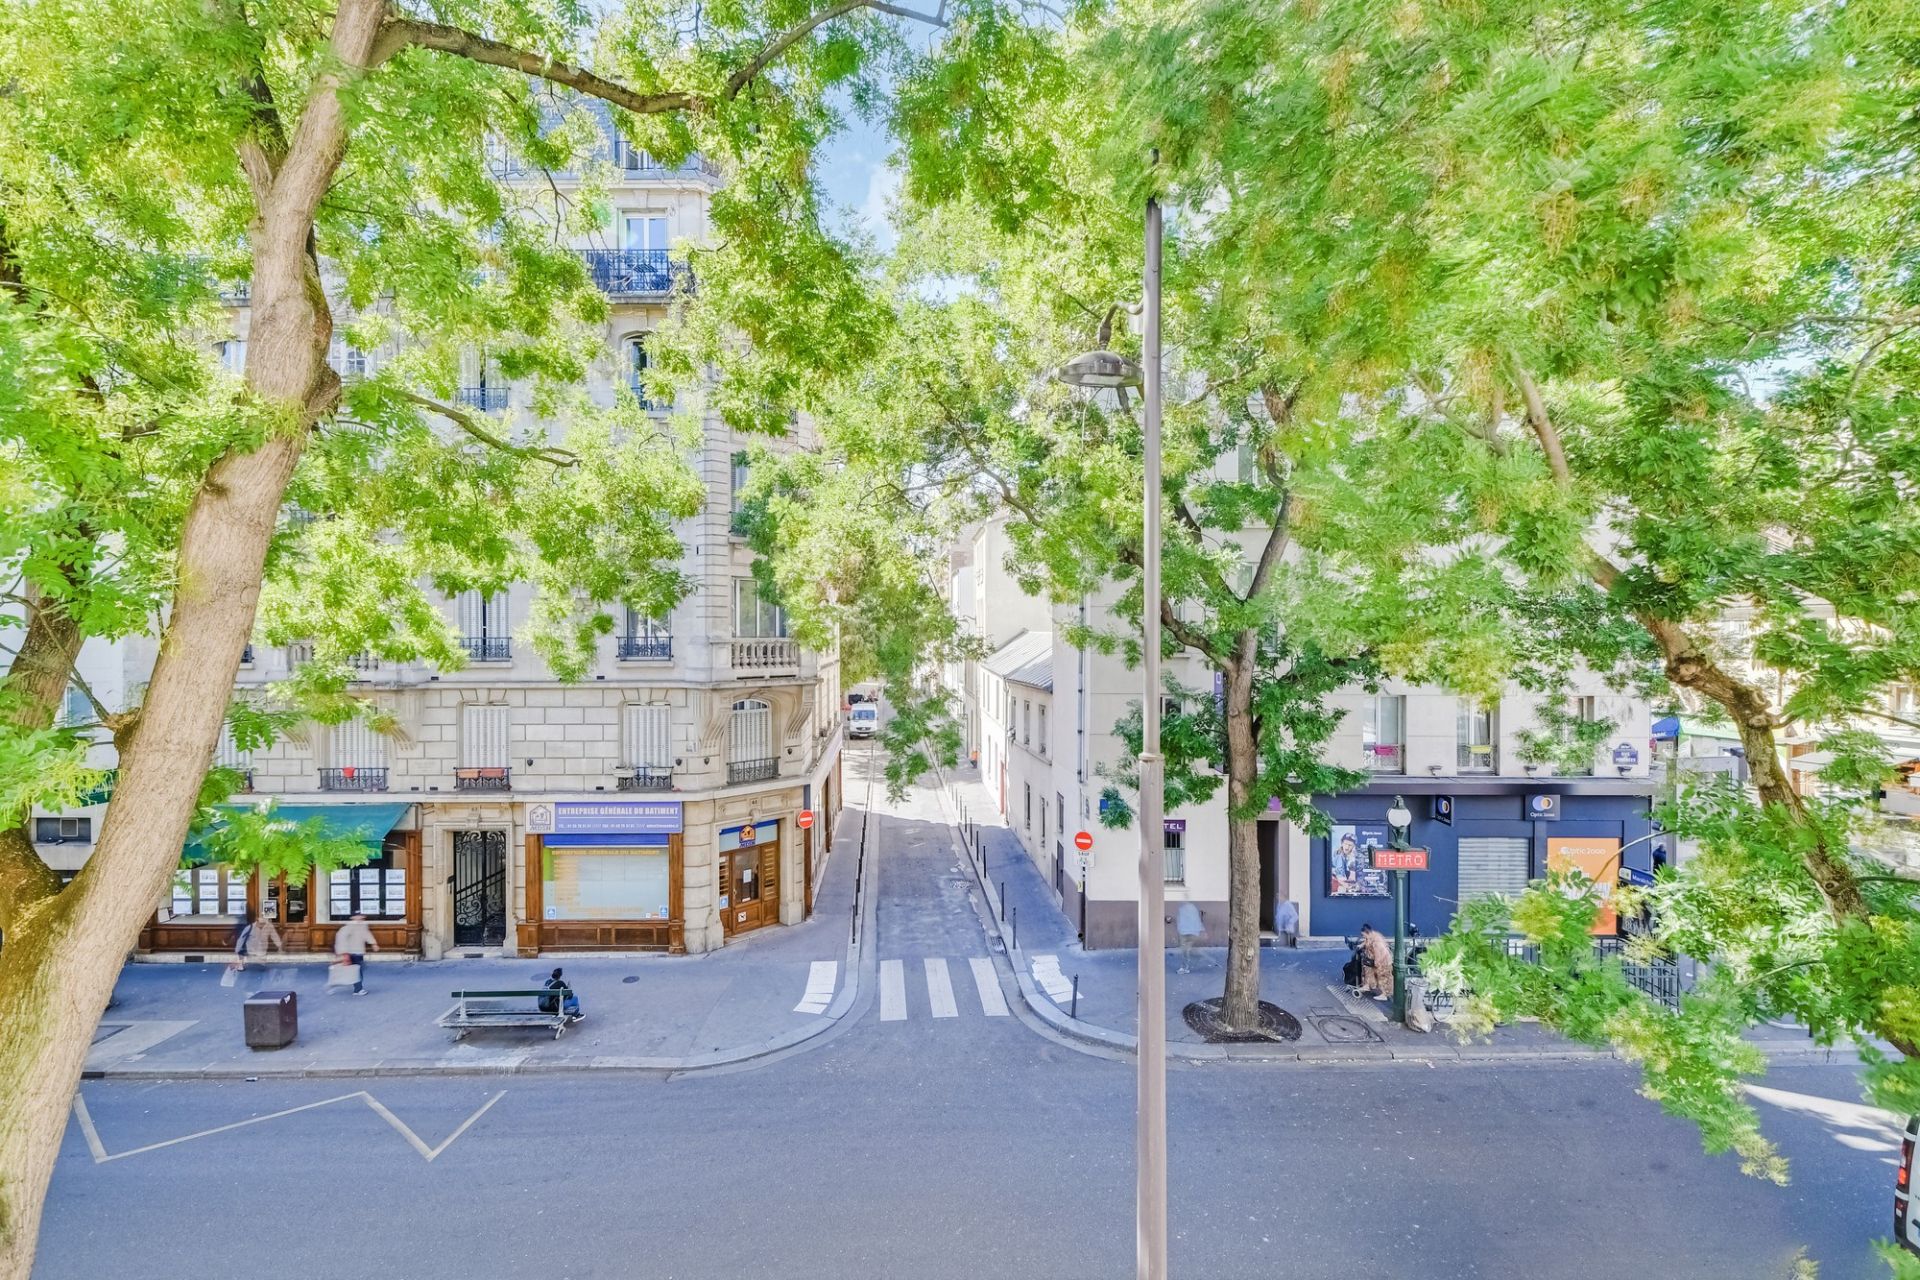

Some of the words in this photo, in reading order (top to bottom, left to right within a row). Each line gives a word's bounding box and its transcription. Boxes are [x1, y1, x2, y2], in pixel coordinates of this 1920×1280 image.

[558, 807, 599, 815] ENTREPRISE
[600, 805, 633, 815] GÉNÉRALE
[634, 807, 644, 815] DU
[1378, 854, 1423, 866] METRO
